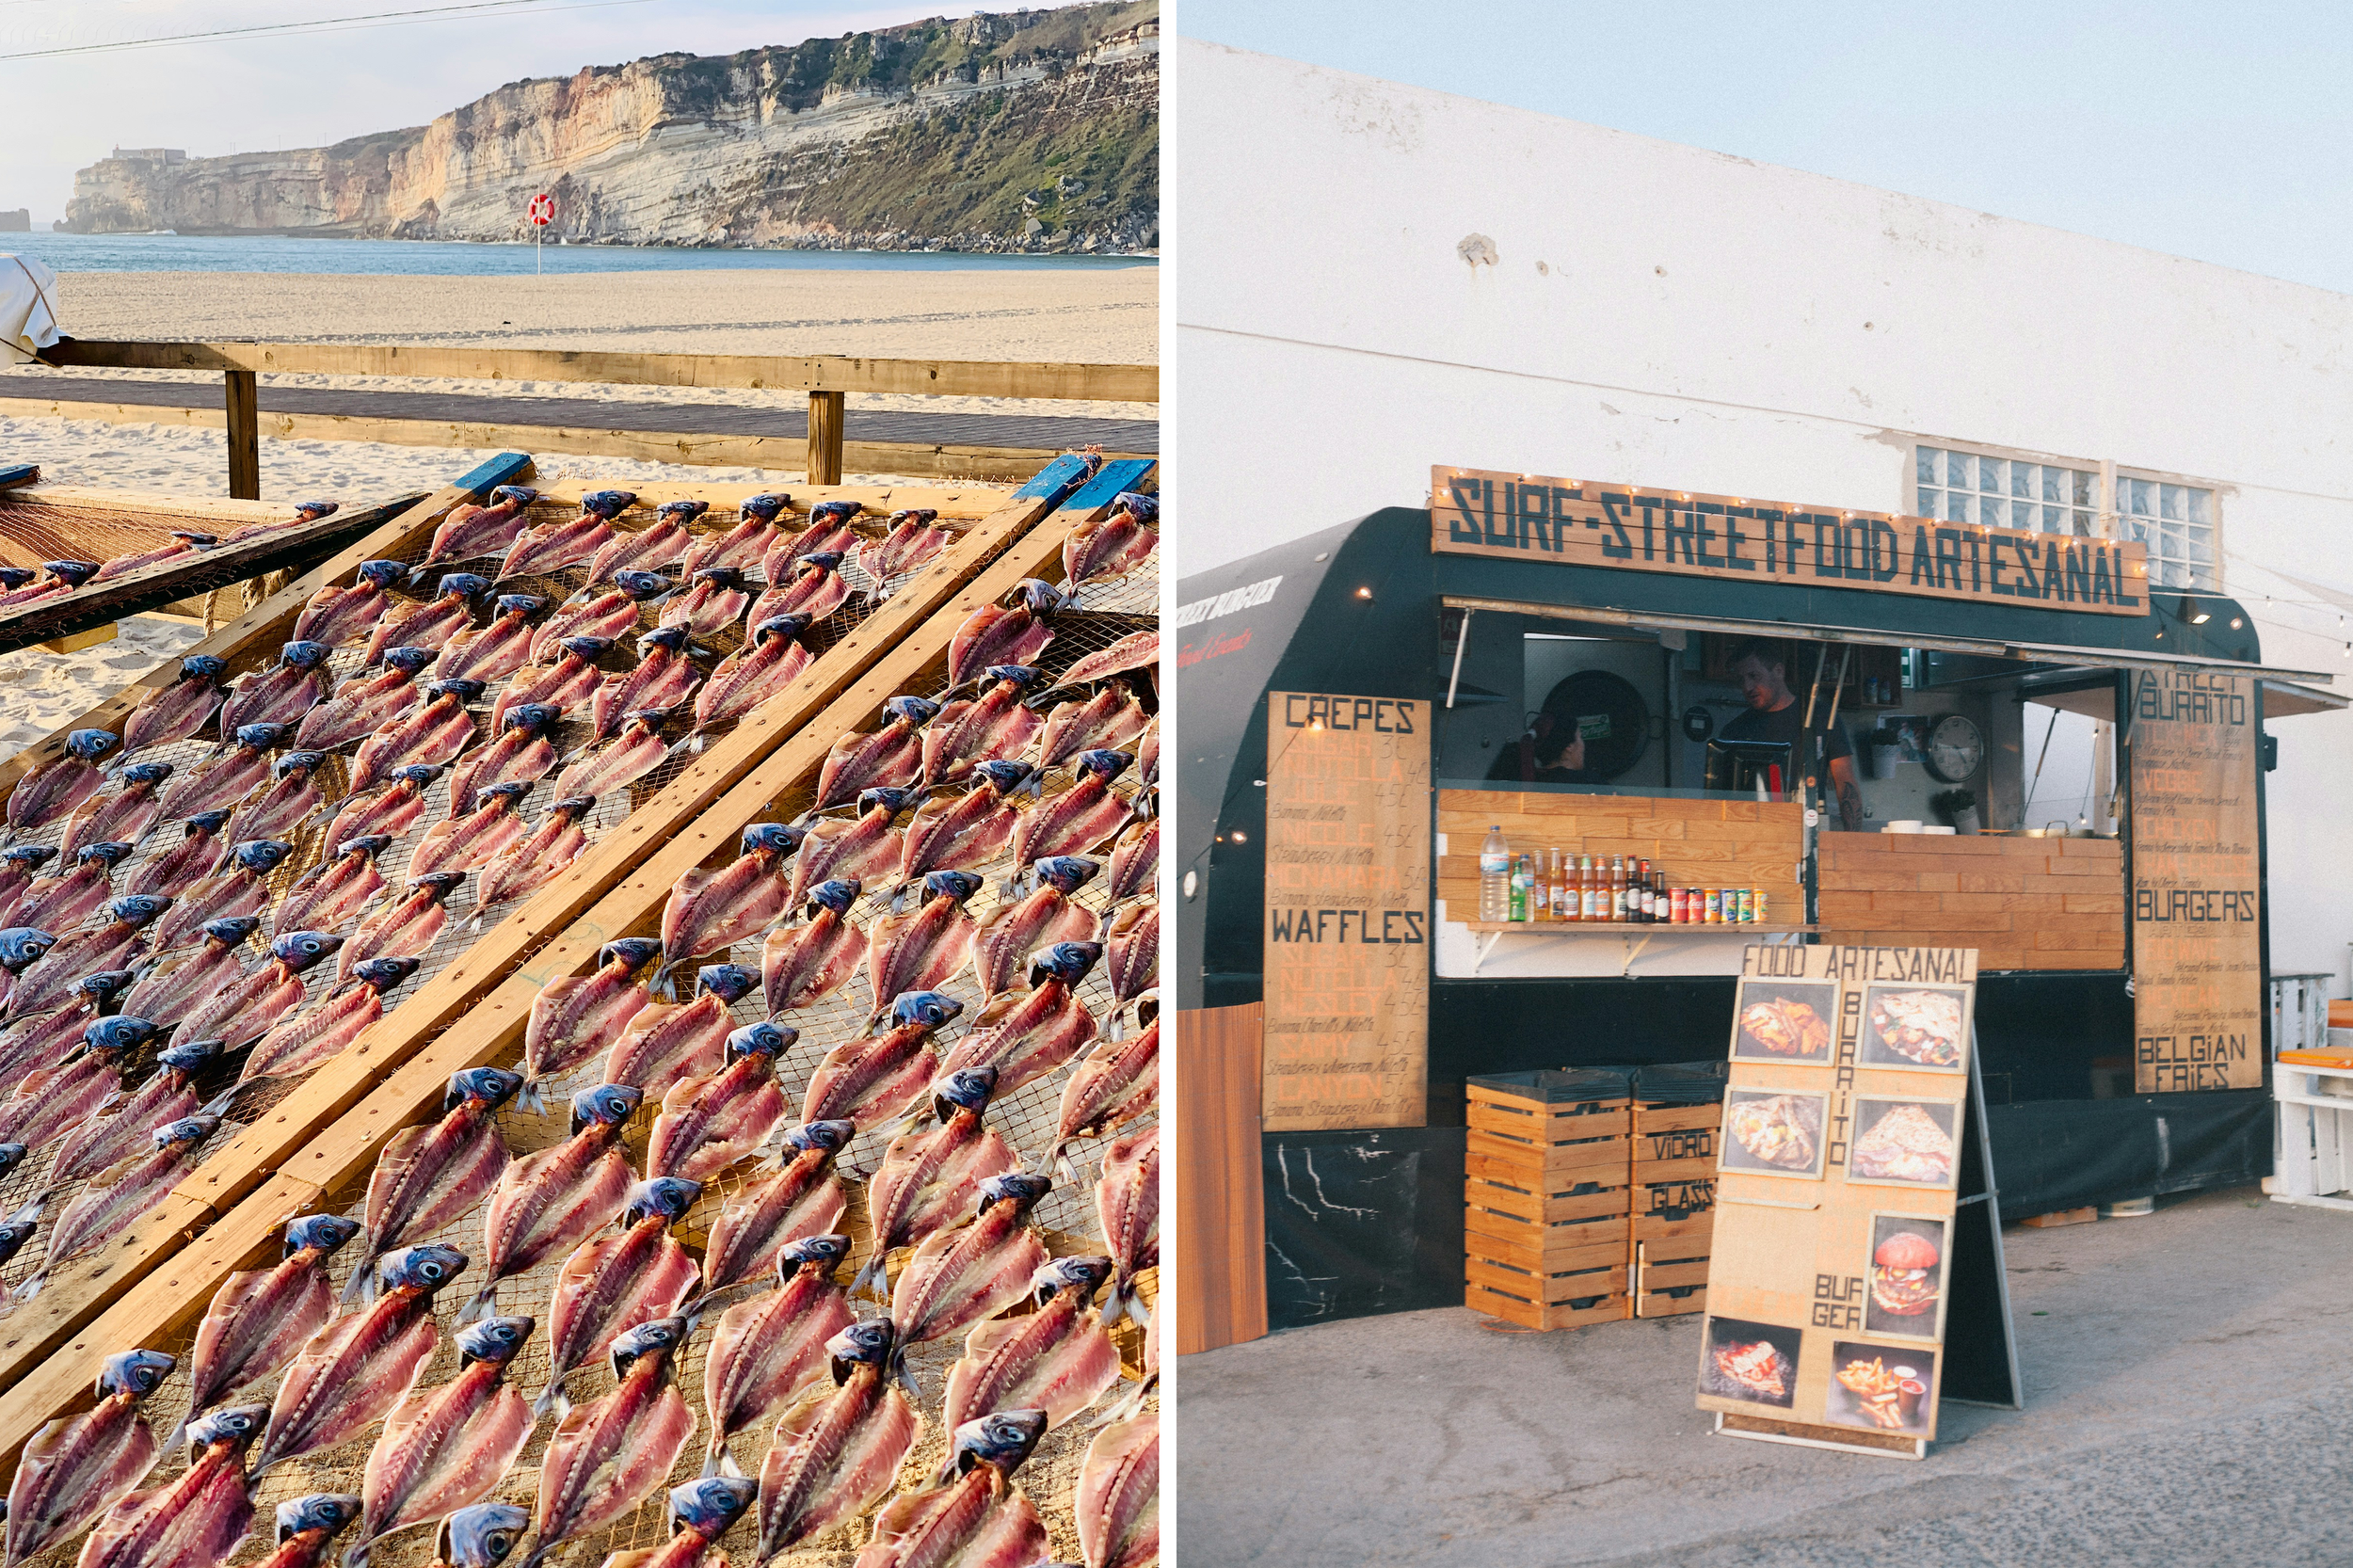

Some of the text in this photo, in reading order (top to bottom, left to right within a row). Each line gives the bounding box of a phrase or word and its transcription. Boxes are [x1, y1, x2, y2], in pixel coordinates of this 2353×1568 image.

[1911, 523, 2139, 607] ARTESANAL
[1286, 695, 1414, 734] CREPES
[1286, 731, 1372, 757] SUGAR
[1284, 755, 1403, 782] NUTELLA
[2137, 889, 2254, 921] BURGERS
[1273, 909, 1424, 944] WAFFLES
[1280, 944, 1367, 968] SUGAR
[1743, 944, 1977, 985] FOOD ARTESANAL
[1280, 968, 1400, 992] NUTELLA
[1280, 991, 1383, 1016] WESLEY
[1278, 1074, 1384, 1100] CANYON
[1652, 1184, 1713, 1211] GLASS
